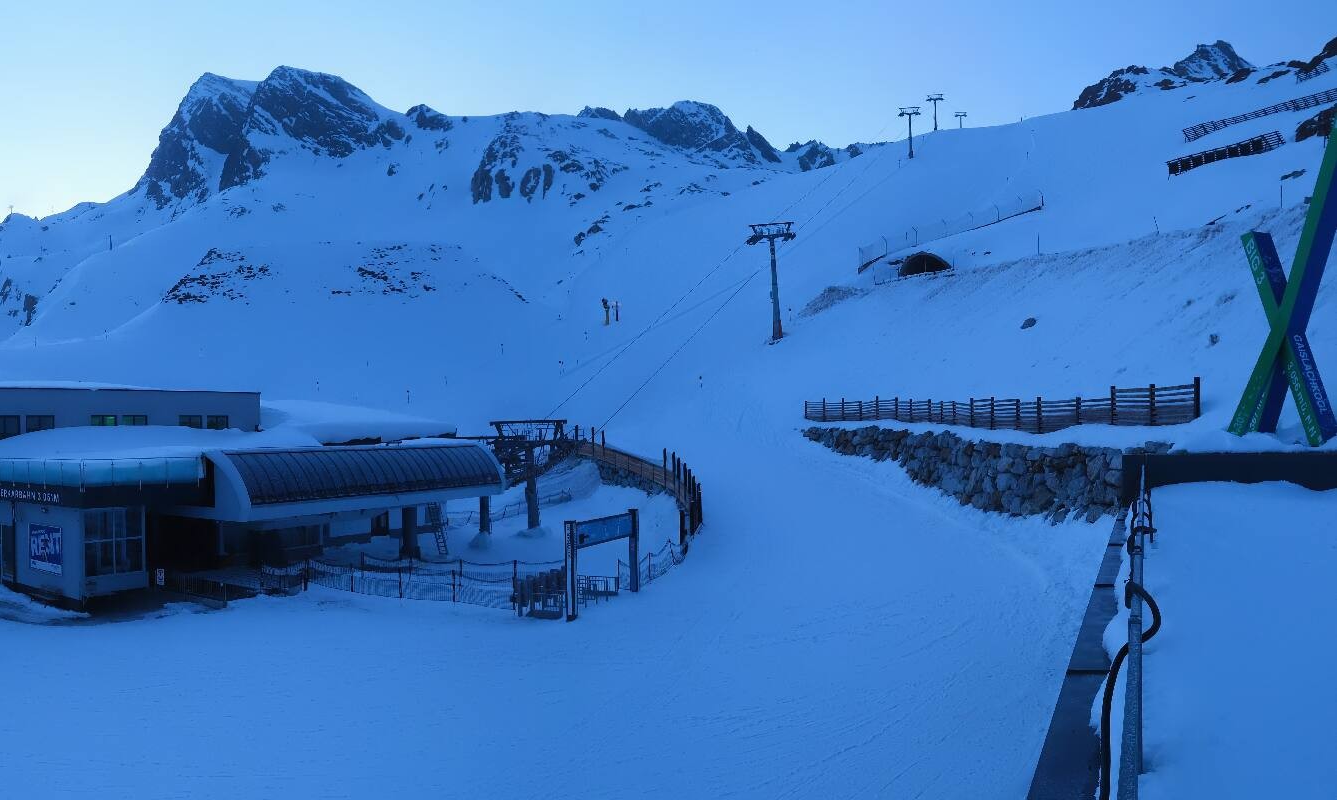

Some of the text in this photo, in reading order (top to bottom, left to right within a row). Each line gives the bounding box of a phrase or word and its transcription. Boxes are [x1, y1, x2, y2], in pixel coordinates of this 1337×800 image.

[1245, 239, 1265, 285] BIG 3
[1293, 334, 1328, 415] GAISLACHKOGL
[30, 532, 61, 557] RENT
